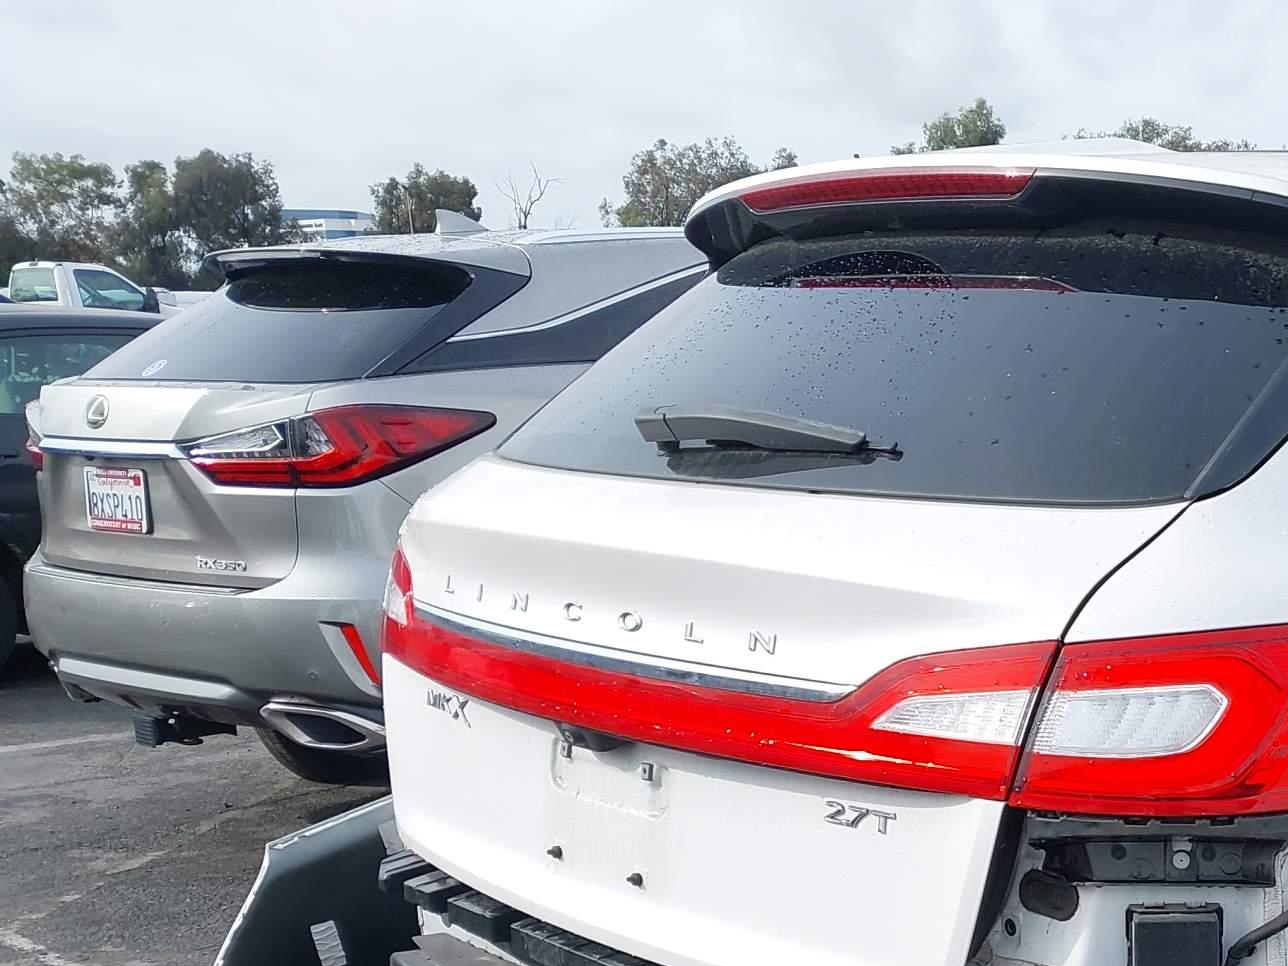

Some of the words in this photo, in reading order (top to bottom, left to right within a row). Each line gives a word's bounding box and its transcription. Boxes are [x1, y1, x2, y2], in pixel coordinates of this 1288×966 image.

[92, 492, 143, 521] 8XSP410
[196, 557, 248, 572] RX350
[445, 574, 777, 656] LINCOLN
[426, 689, 471, 729] MKX
